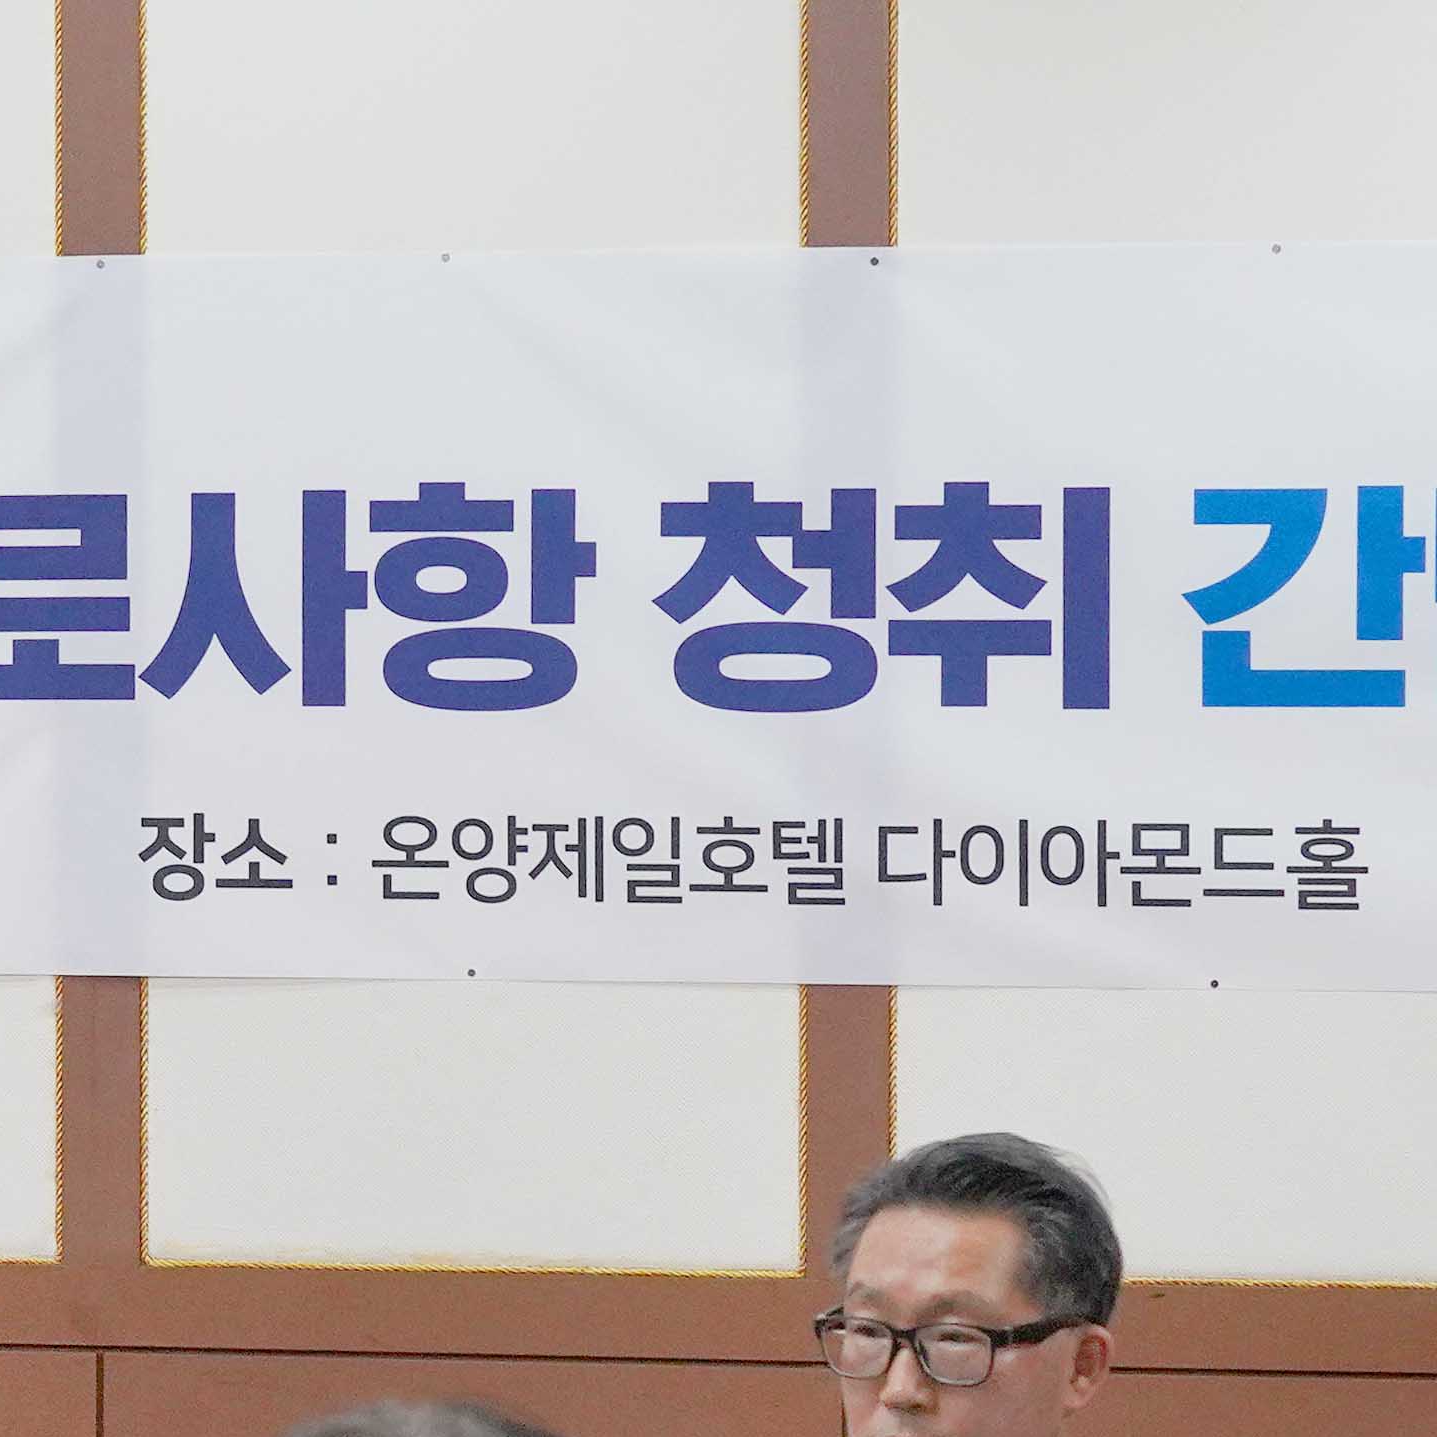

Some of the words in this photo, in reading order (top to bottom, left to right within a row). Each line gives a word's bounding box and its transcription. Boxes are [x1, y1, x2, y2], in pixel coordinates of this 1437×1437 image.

[651, 480, 1111, 713] 청취
[1180, 485, 1437, 707] 간
[136, 812, 294, 902] 장소
[370, 814, 847, 906] 온양제일호텔
[877, 817, 1370, 911] 다이아몬드홀
